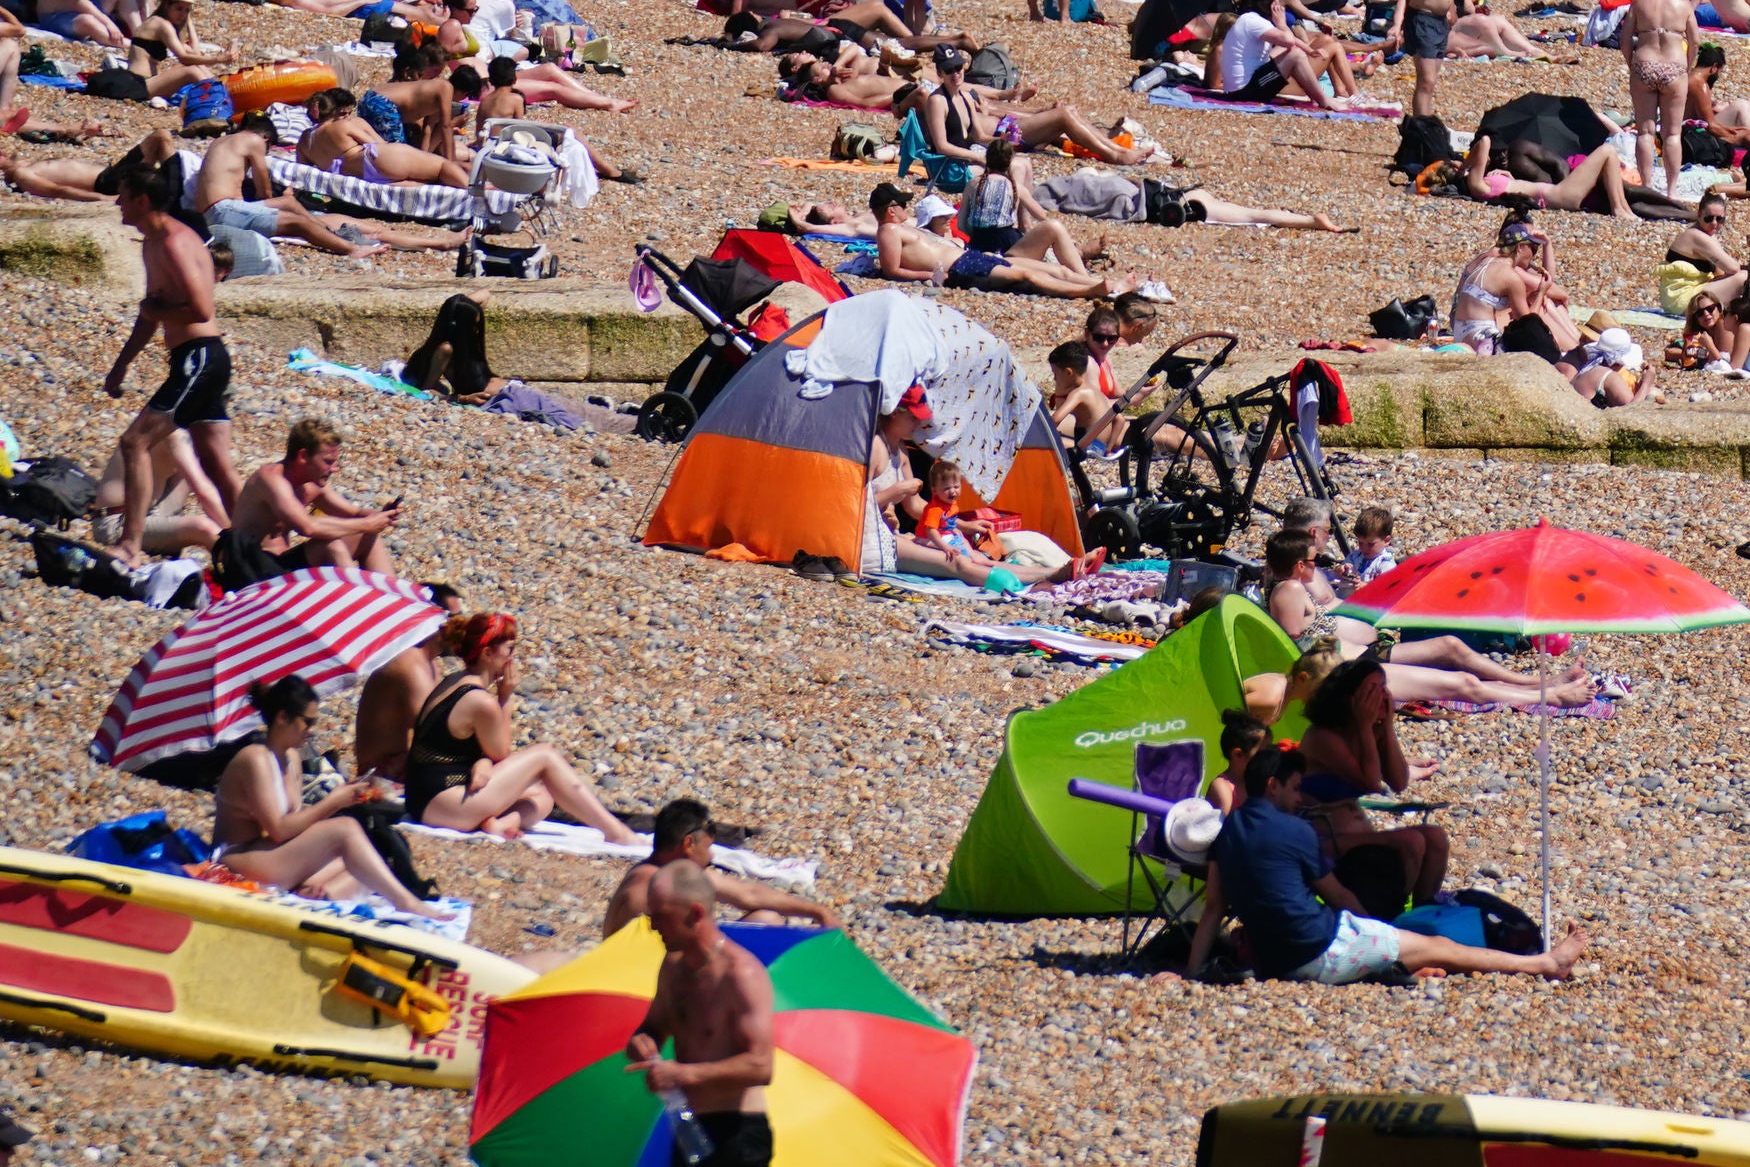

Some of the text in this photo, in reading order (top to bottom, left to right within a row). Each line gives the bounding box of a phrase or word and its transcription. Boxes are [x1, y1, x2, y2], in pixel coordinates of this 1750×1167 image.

[945, 48, 955, 59] C
[1074, 719, 1187, 748] Quechua
[1272, 1098, 1446, 1125] BENNETT
